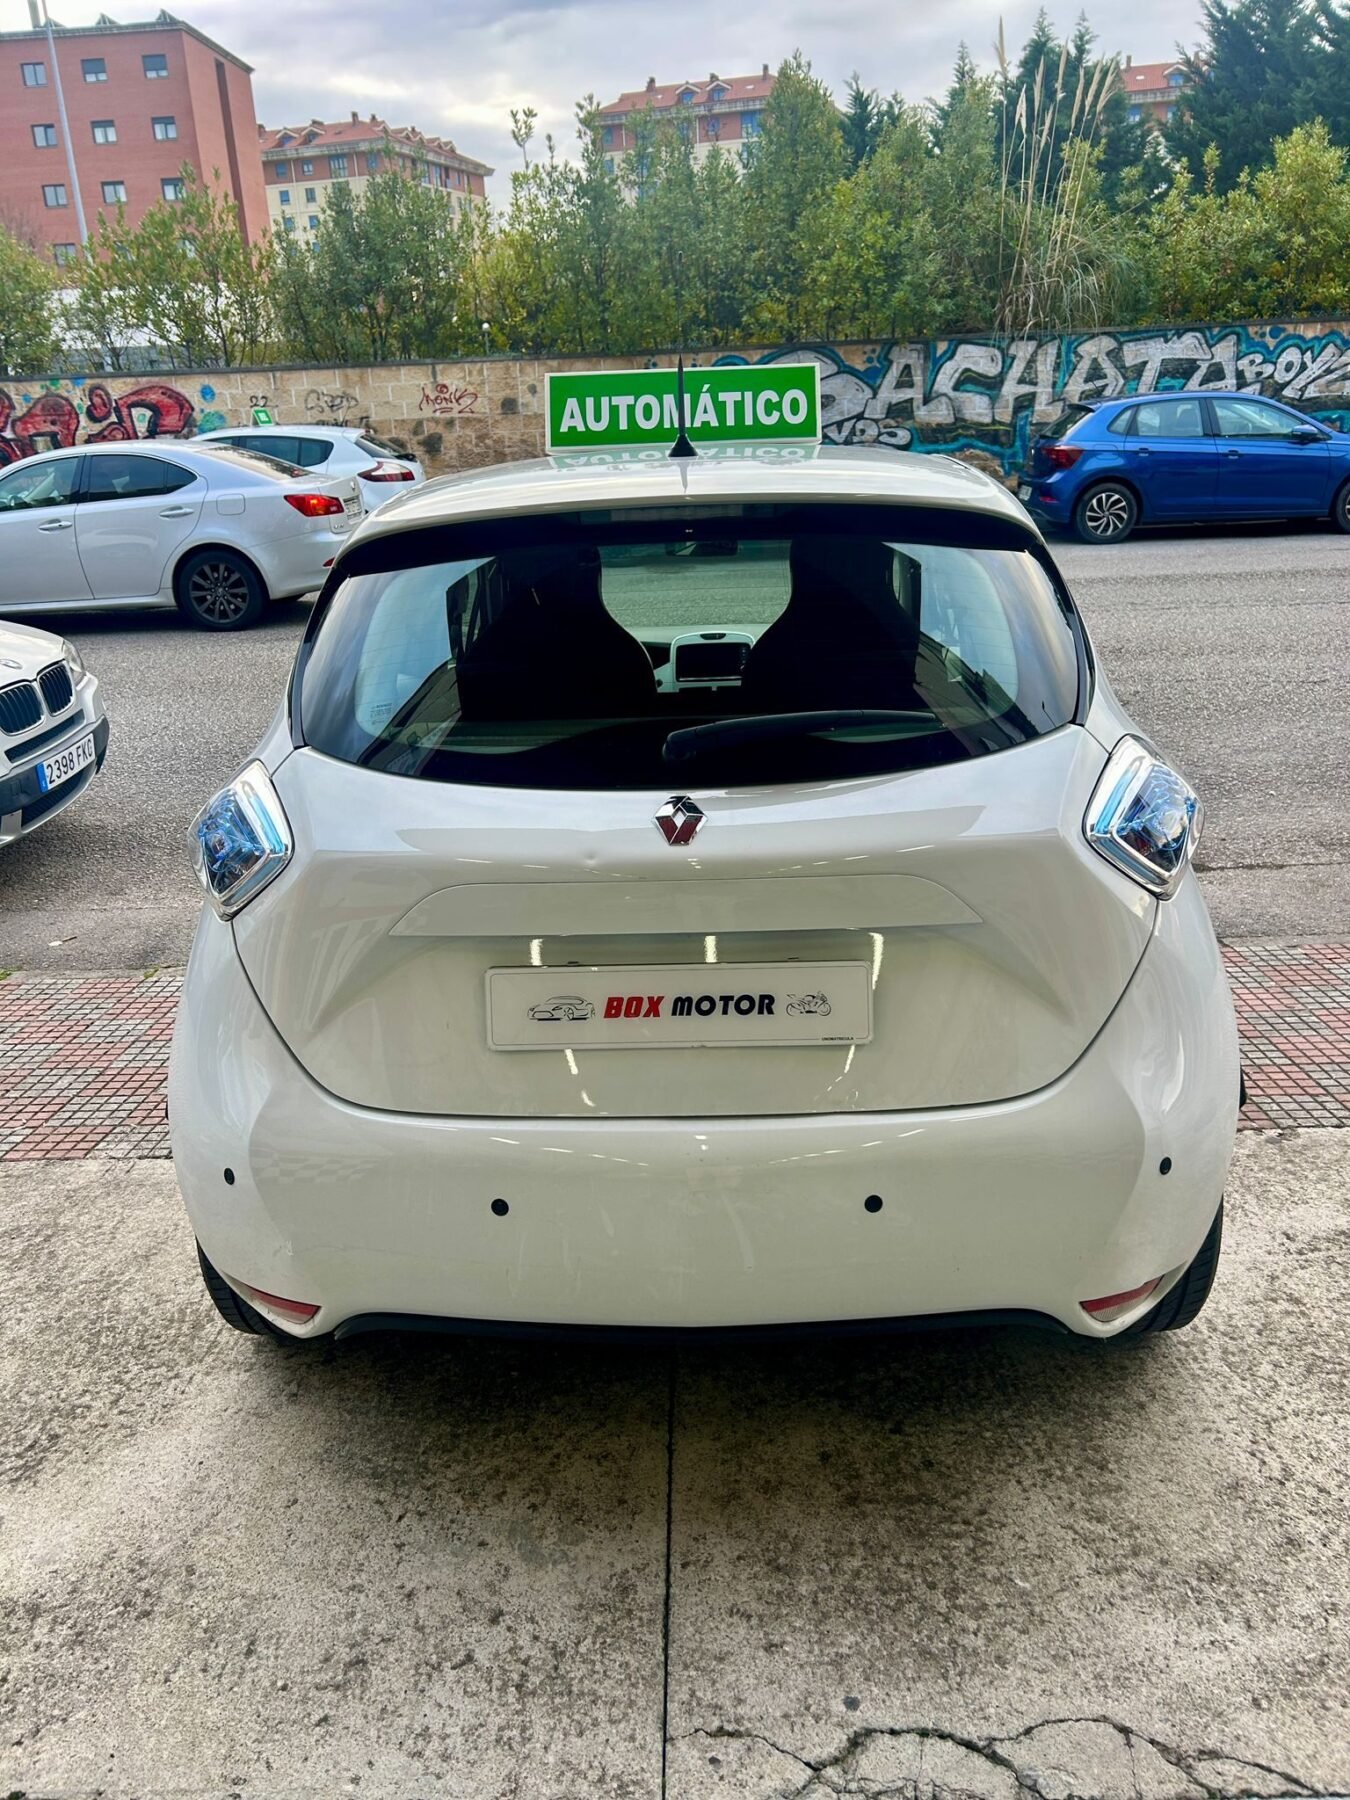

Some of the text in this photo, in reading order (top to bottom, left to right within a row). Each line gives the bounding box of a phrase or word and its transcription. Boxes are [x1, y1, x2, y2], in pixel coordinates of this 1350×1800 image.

[559, 384, 808, 433] AUTOMÁTICO
[46, 751, 75, 785] 2398
[603, 994, 776, 1019] BOX MOTOR
